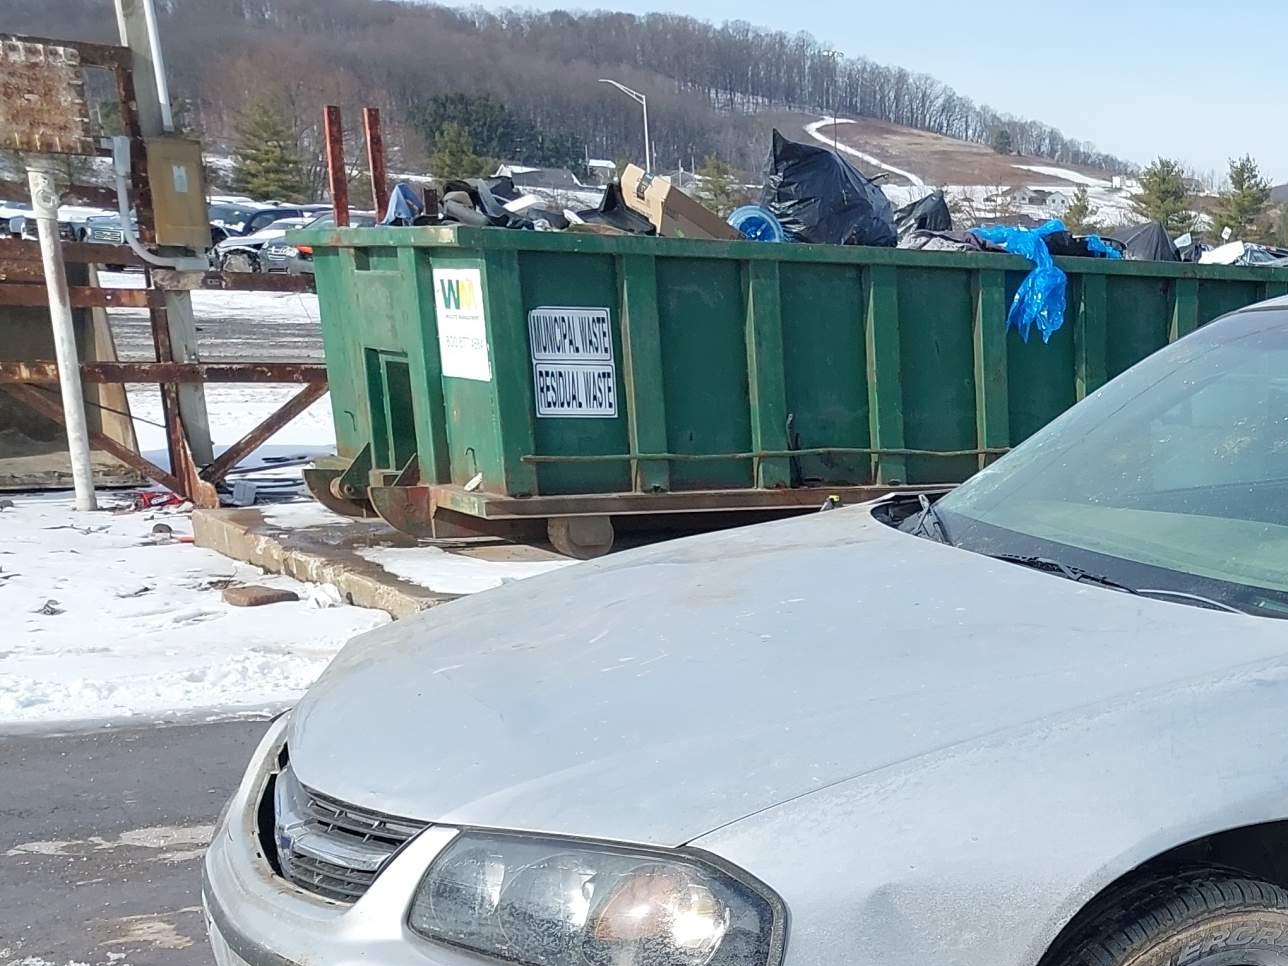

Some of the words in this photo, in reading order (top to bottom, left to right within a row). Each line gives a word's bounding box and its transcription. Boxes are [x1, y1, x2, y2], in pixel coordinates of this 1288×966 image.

[533, 315, 579, 353] MUNICIPAL
[579, 316, 609, 354] WASTE
[538, 370, 582, 408] RESIDUAL
[584, 371, 613, 408] WASTE
